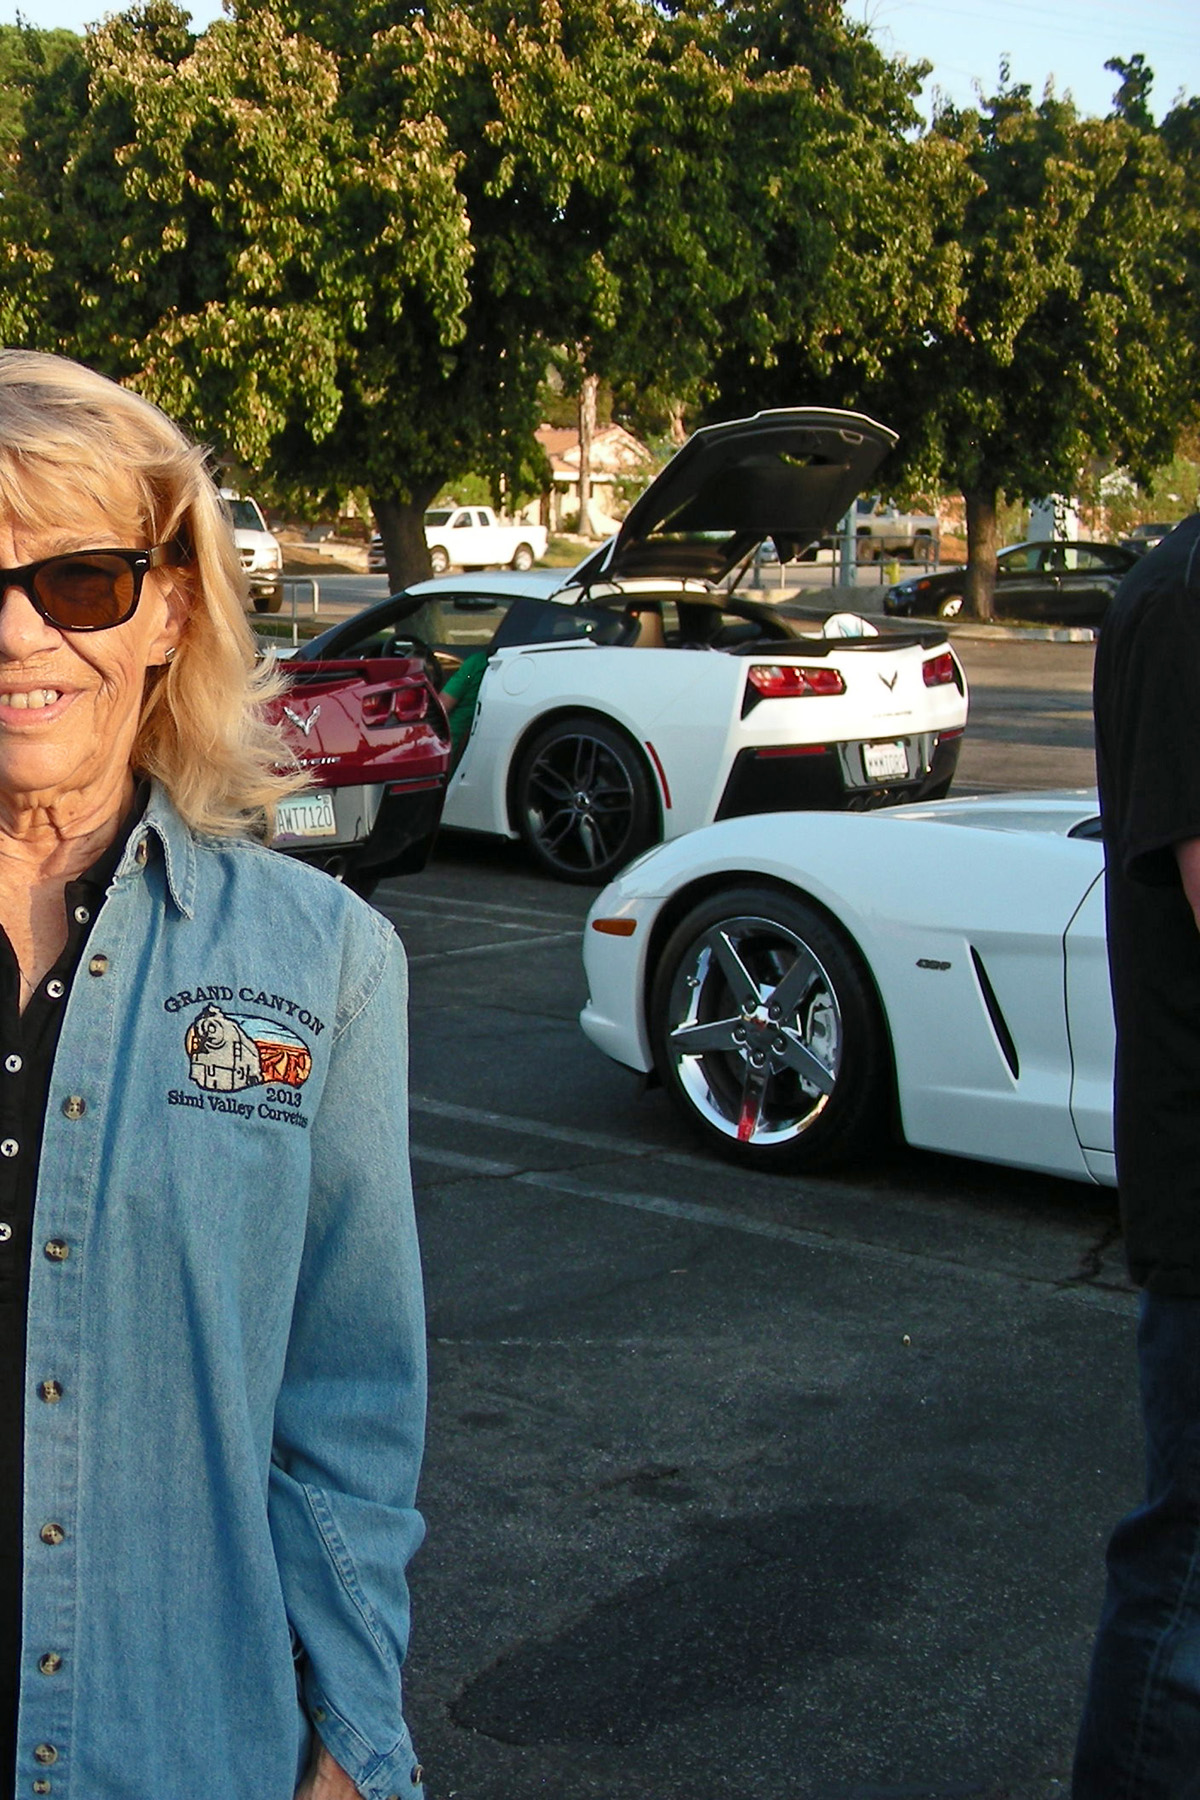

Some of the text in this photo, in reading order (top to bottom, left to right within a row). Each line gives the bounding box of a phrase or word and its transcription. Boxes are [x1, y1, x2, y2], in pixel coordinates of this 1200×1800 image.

[277, 805, 333, 833] AWT7120
[164, 986, 325, 1036] GRAND CANYON
[167, 1090, 205, 1109] Simi
[207, 1095, 254, 1119] Valley
[266, 1087, 303, 1108] 2013
